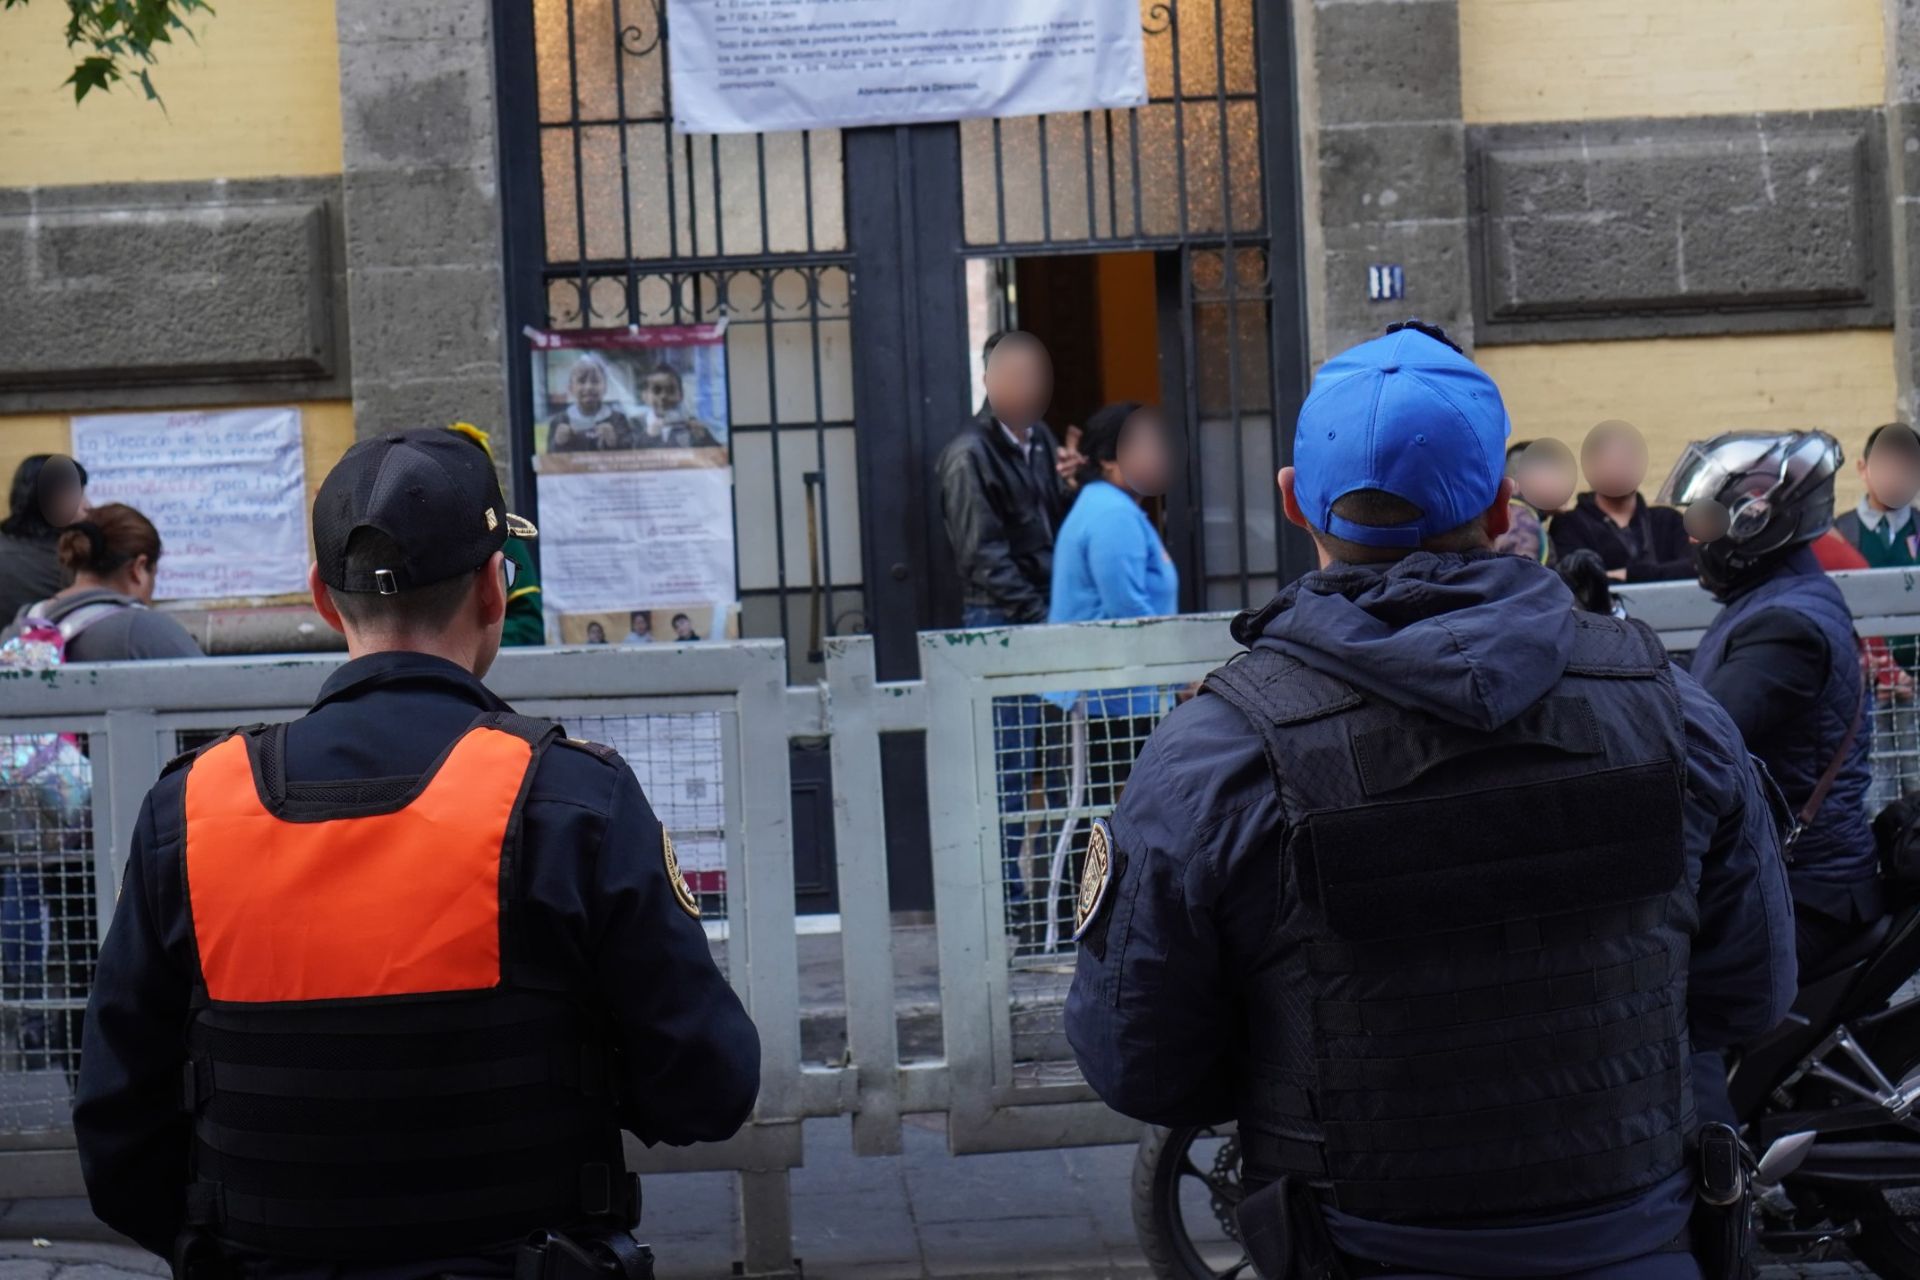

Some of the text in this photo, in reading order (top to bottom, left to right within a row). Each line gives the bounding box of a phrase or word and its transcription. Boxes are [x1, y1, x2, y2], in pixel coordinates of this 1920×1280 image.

[864, 31, 929, 43] perfectamente
[931, 28, 980, 39] uniformado
[857, 84, 919, 96] Atentamente
[921, 83, 931, 92] la
